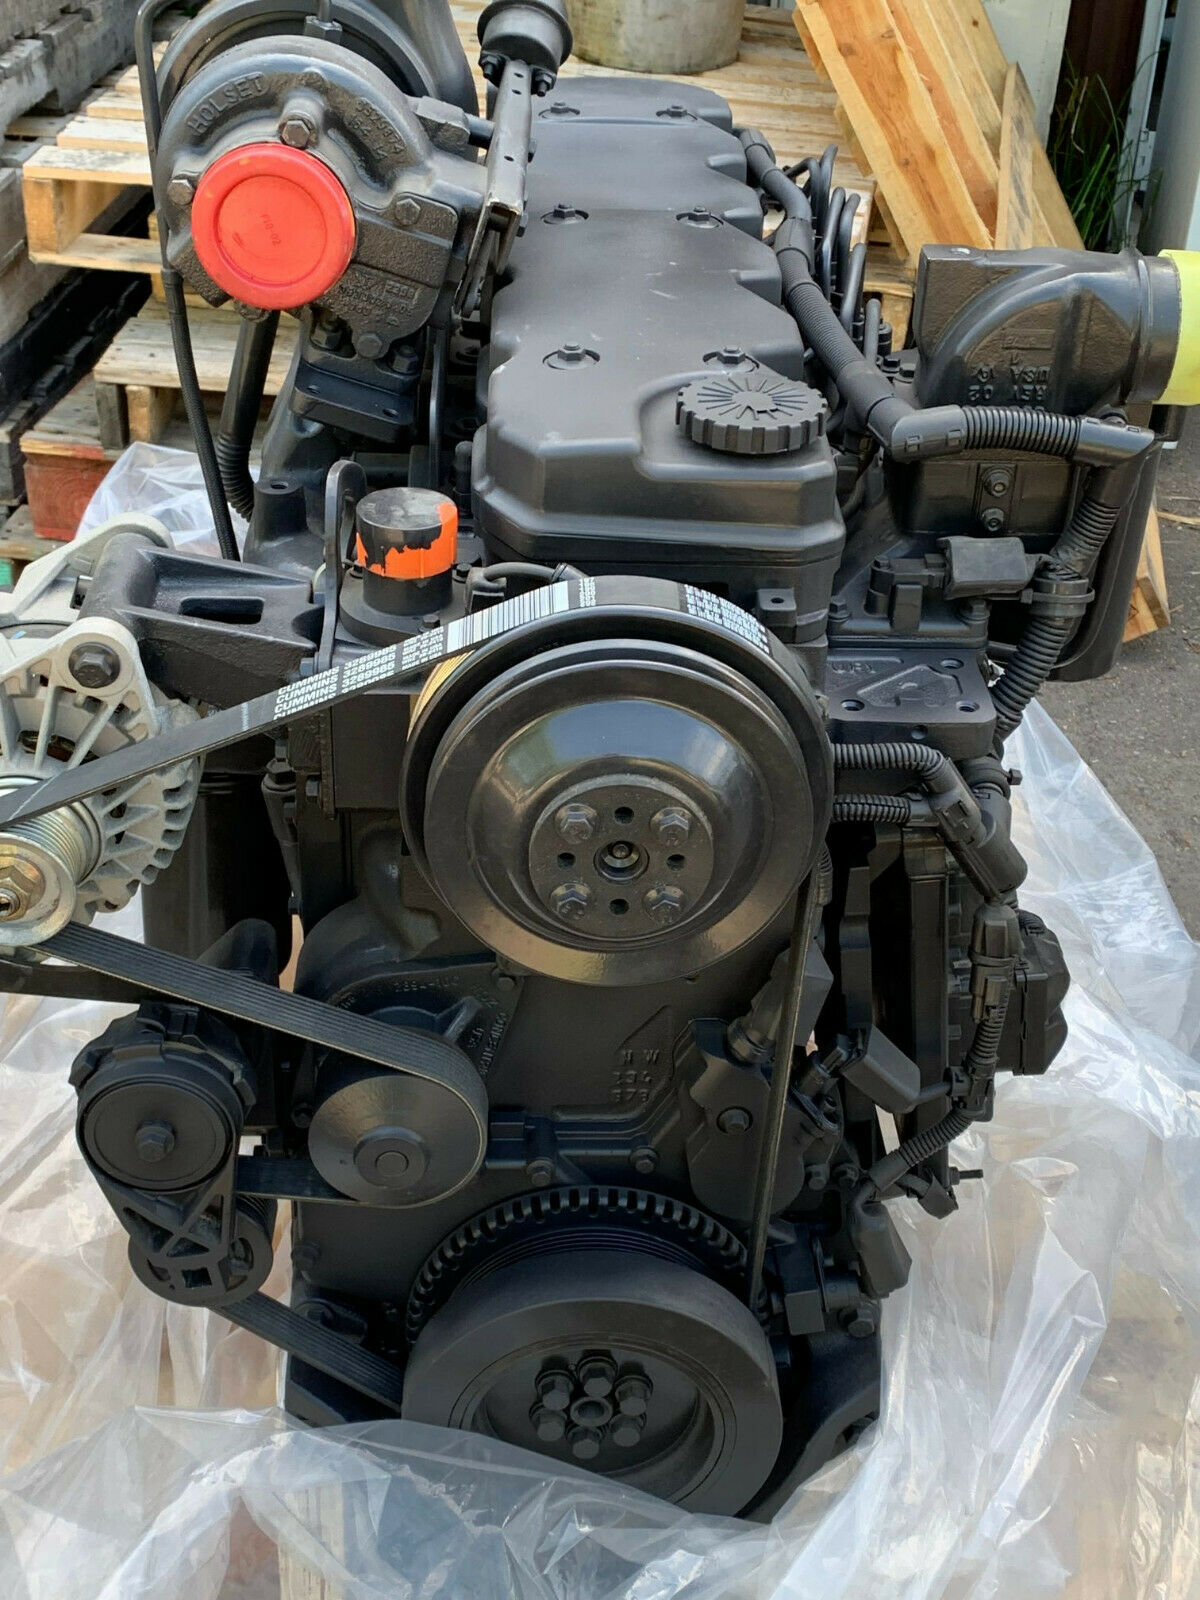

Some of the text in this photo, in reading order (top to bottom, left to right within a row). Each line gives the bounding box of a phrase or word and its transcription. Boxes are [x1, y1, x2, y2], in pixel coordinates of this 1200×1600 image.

[187, 73, 265, 136] HOLSET
[274, 661, 395, 714] CUMMINS 3289985
[276, 652, 396, 704] CUMMINS 3289985
[278, 665, 340, 696] CUMMINS
[343, 644, 397, 670] 3289985
